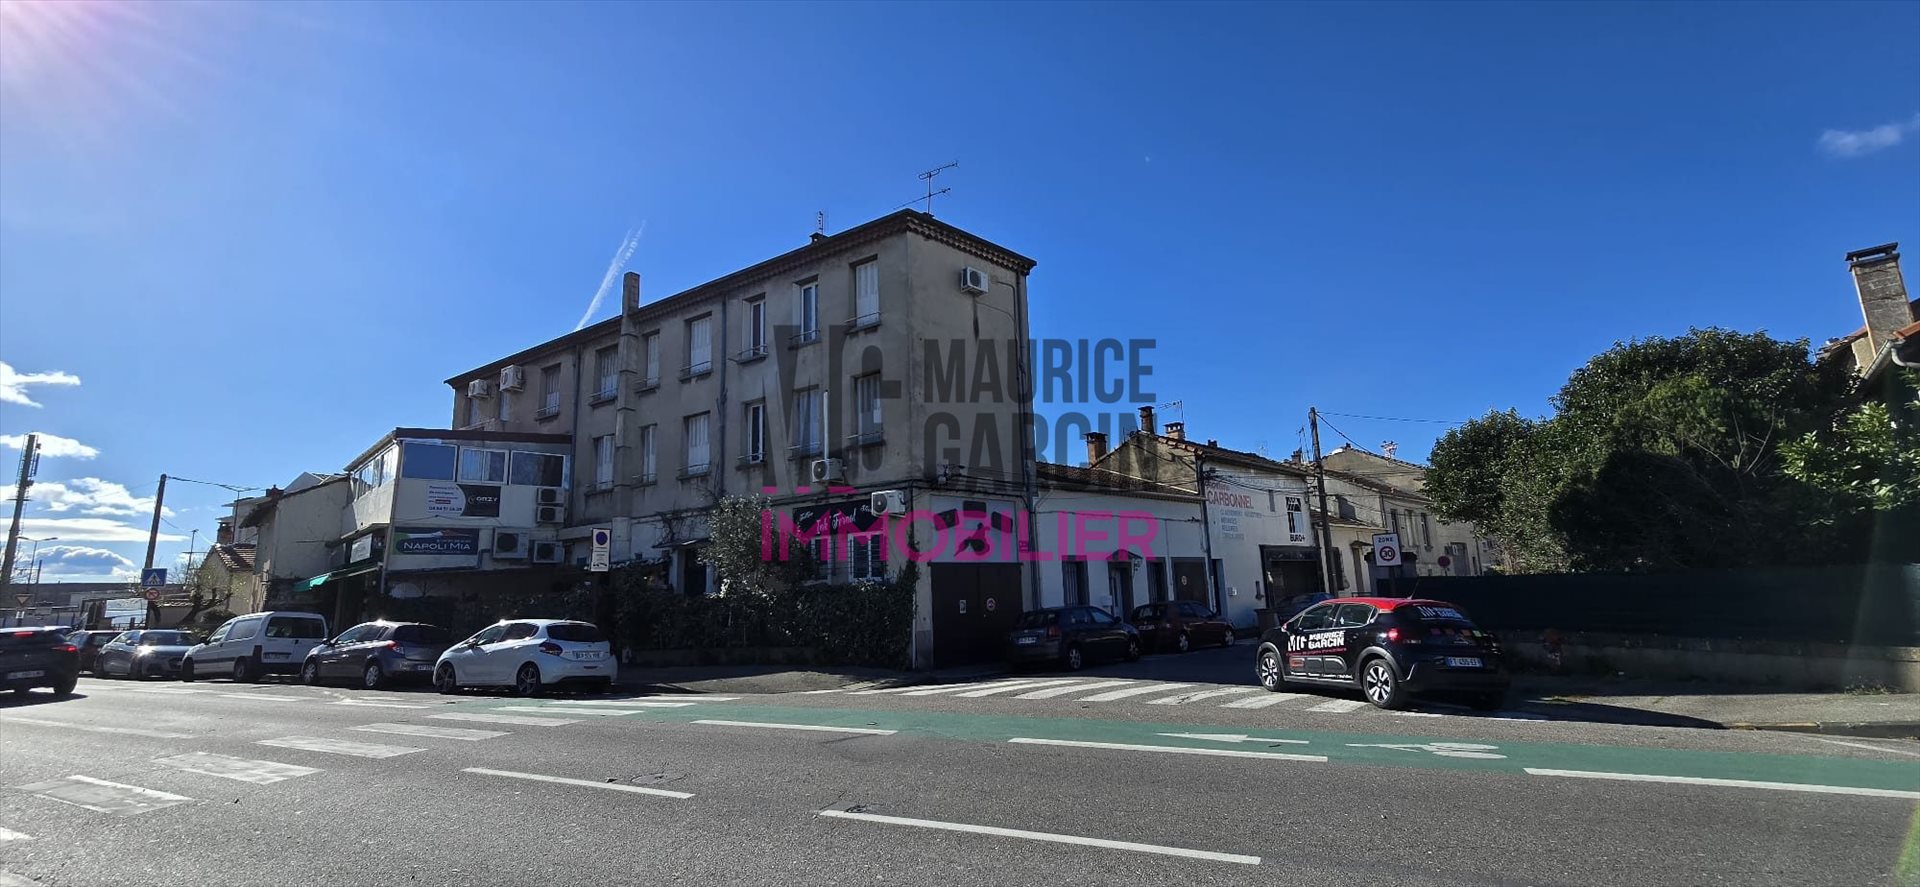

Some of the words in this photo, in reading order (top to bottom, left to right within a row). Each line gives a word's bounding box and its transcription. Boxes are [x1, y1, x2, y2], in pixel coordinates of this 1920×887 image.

[1207, 490, 1254, 509] CARBONNEL
[403, 542, 447, 550] NAPOLI
[1381, 550, 1393, 558] 30
[1308, 637, 1345, 650] GARCIN
